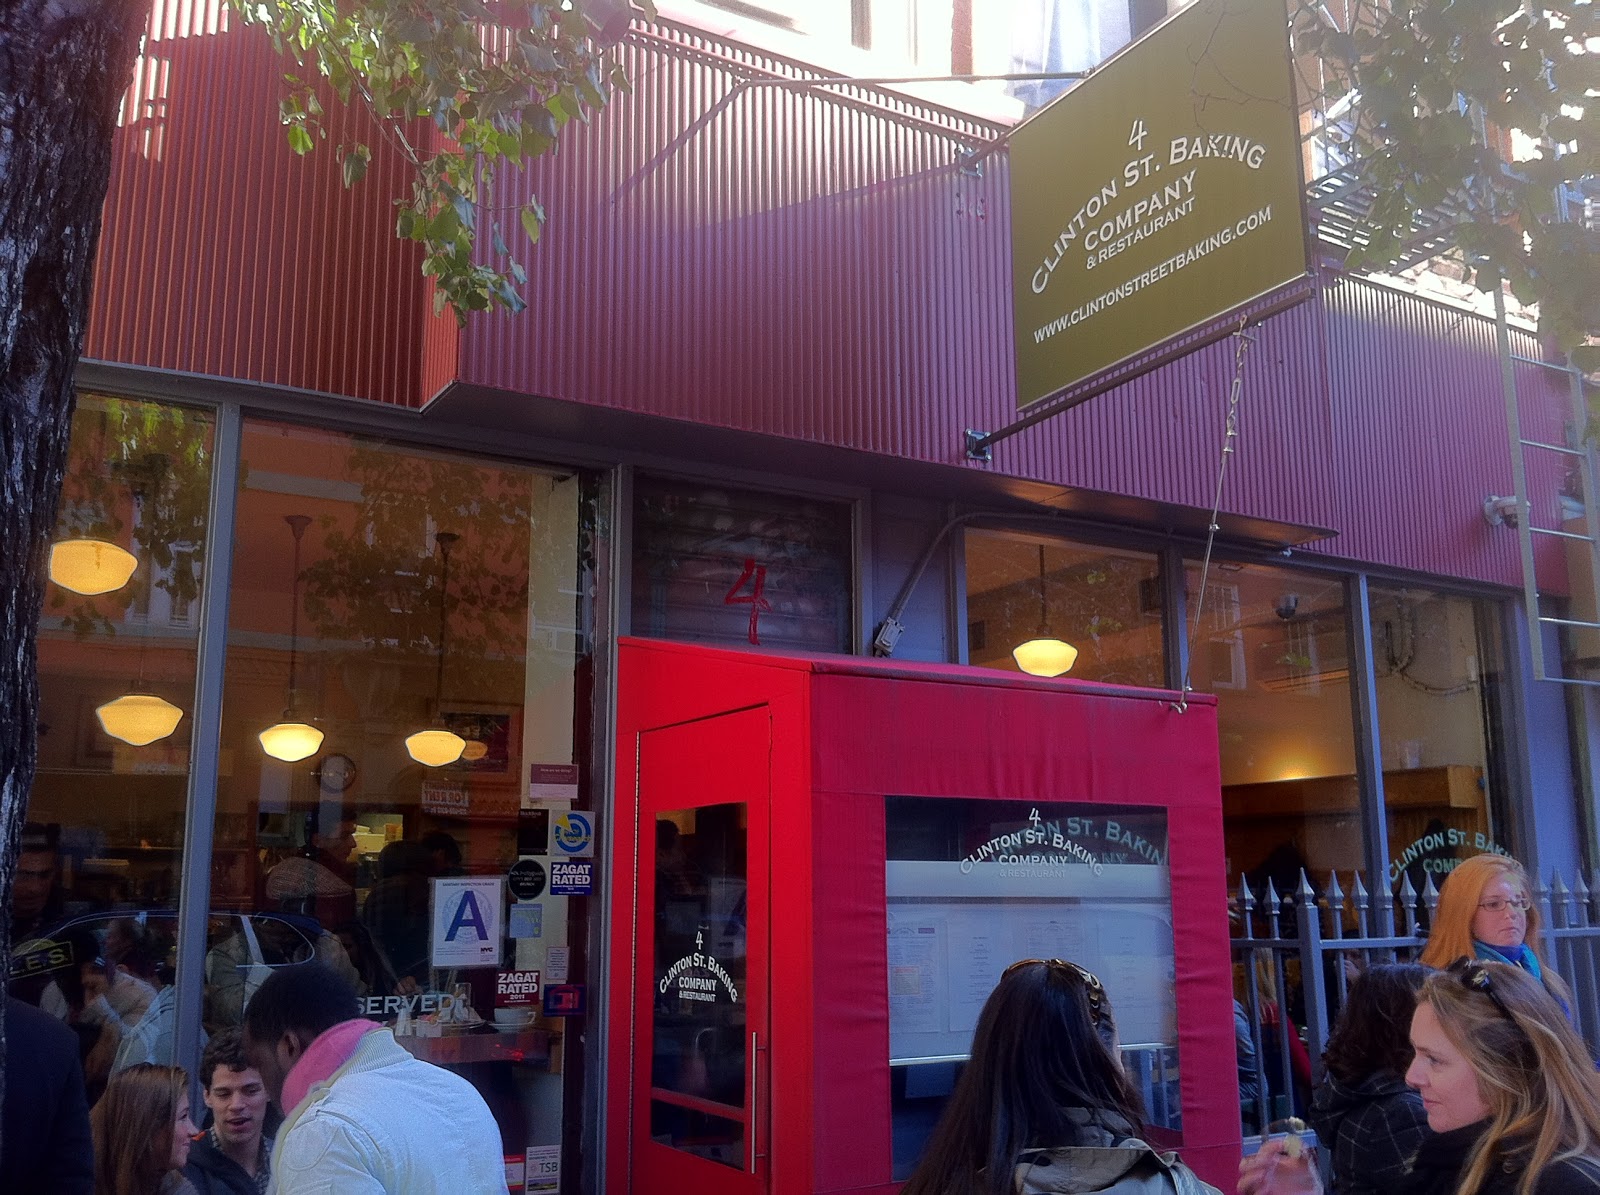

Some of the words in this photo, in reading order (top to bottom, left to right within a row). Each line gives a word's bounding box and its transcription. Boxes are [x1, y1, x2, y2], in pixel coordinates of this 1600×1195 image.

[1128, 119, 1148, 151] 4
[1031, 180, 1118, 294] CLINTON
[1124, 153, 1160, 188] ST.
[1169, 134, 1266, 169] BAKING
[1084, 168, 1197, 251] COMPANY
[1086, 255, 1097, 270] &
[1098, 197, 1195, 263] RESTAURANT
[1033, 204, 1272, 344] WWW.CLINTONSTREETBAKING.COM
[724, 556, 772, 645] 4
[1029, 807, 1042, 827] 4
[1067, 817, 1098, 838] ST.
[960, 833, 1021, 875] CLINTON
[1025, 829, 1048, 846] ST.
[1052, 832, 1103, 876] BAKING
[998, 854, 1068, 868] COMPANY
[1389, 832, 1445, 882] CLINTON
[1447, 828, 1471, 846] ST.
[552, 864, 591, 874] ZAGAT
[1008, 869, 1066, 879] RESTAURANT
[552, 875, 591, 885] RATED
[444, 890, 489, 942] A
[695, 930, 704, 950] 4
[498, 972, 539, 983] ZAGAT
[660, 955, 692, 994] CLINTON
[693, 952, 707, 968] ST.
[707, 956, 738, 1003] BAKING
[678, 976, 717, 991] COMPANY
[497, 983, 538, 994] RATED
[684, 991, 716, 1002] RESTAURANT
[539, 1162, 558, 1173] TSB
